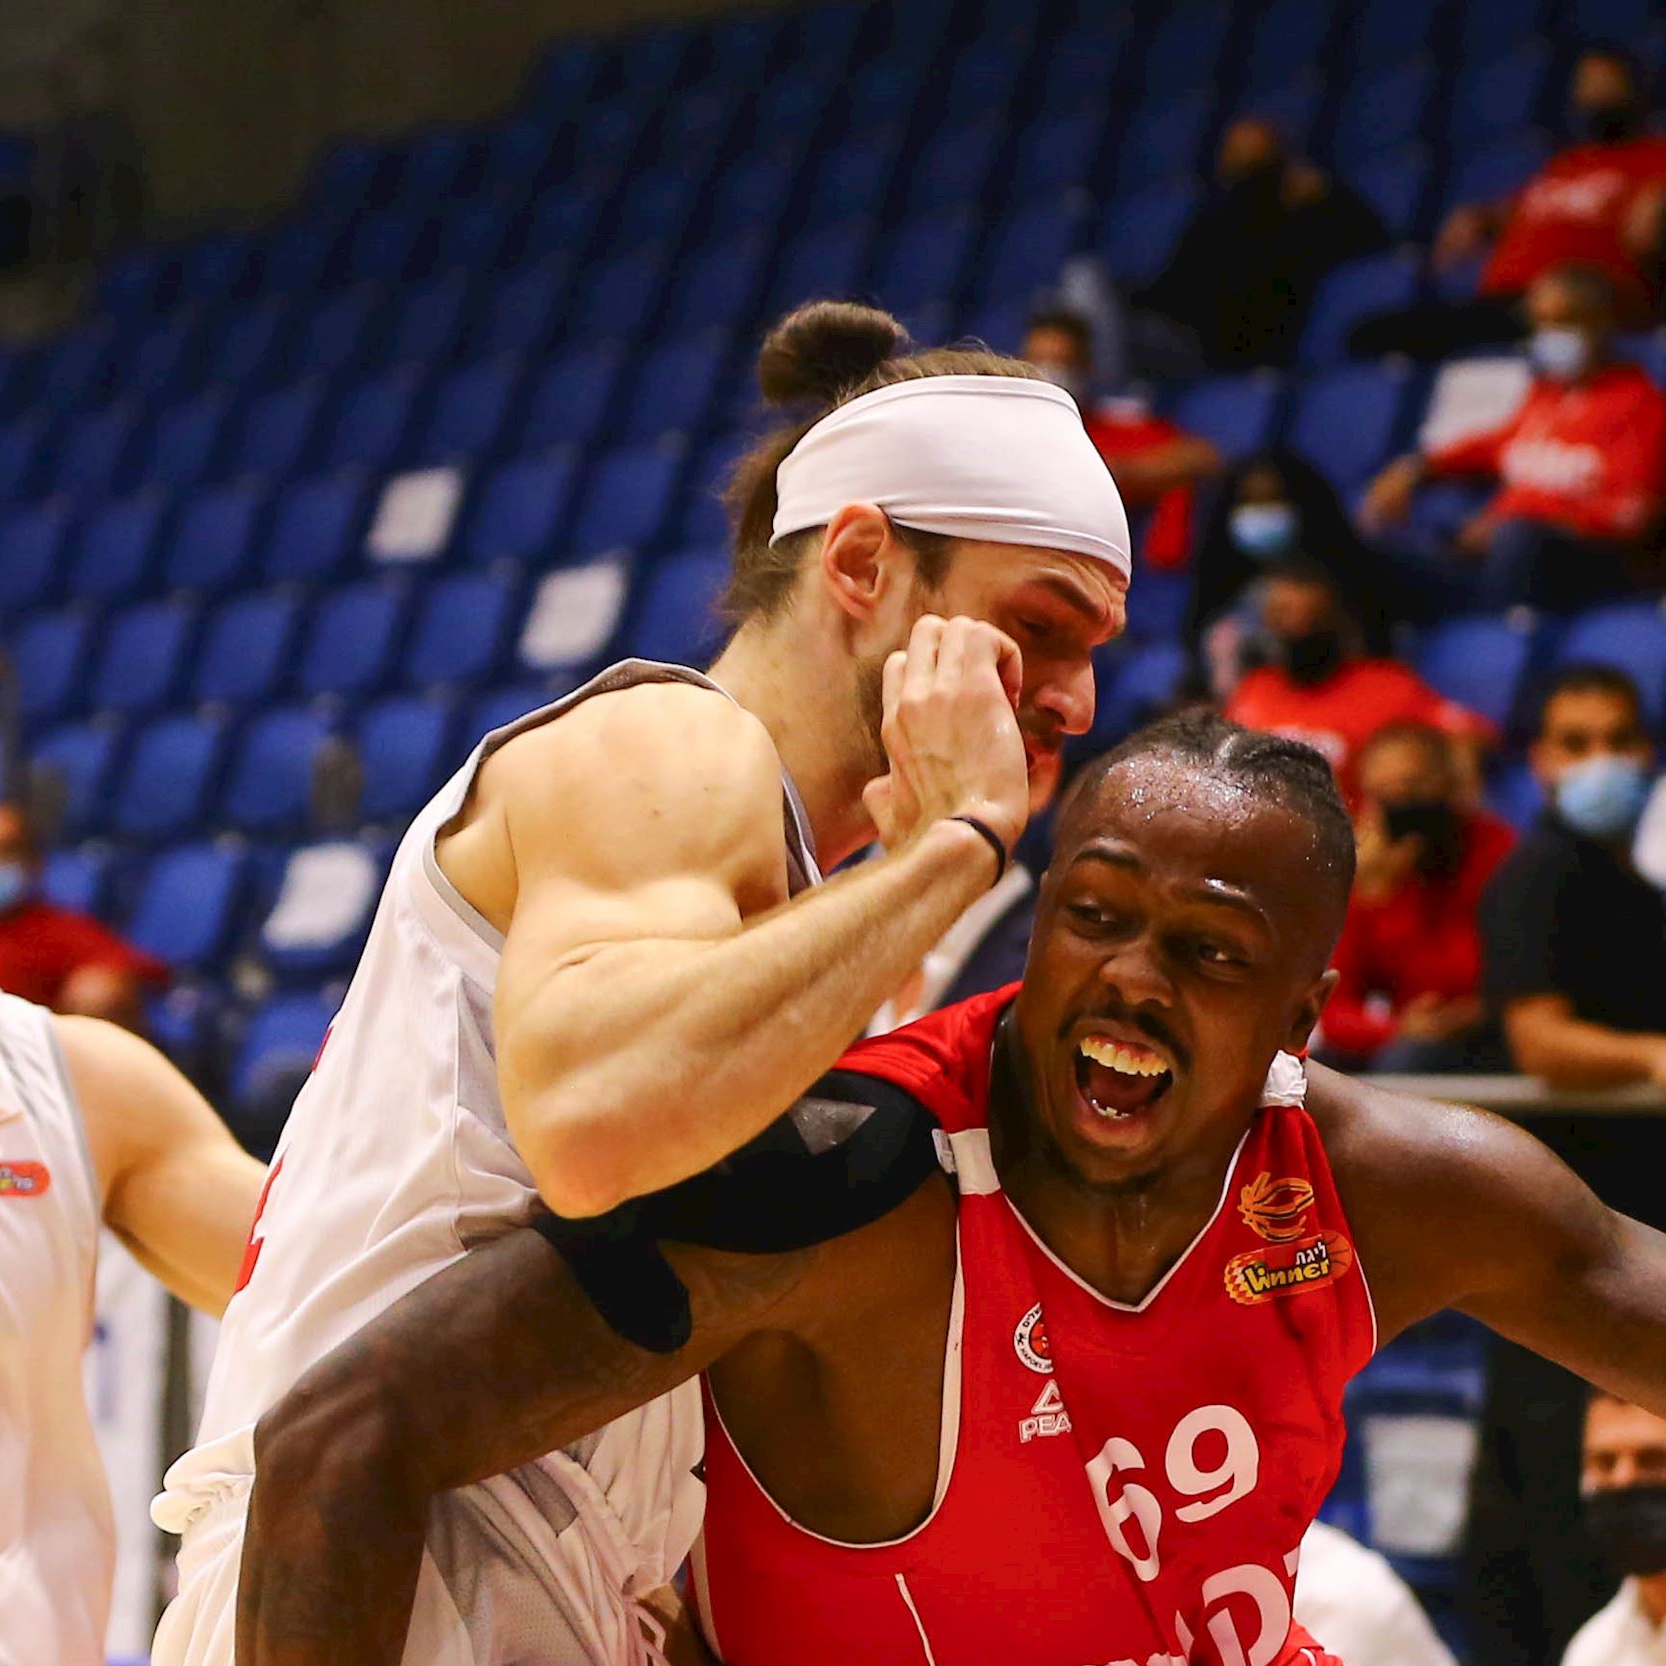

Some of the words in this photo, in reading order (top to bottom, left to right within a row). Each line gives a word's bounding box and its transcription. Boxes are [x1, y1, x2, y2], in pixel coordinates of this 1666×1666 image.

[1295, 1241, 1328, 1266] ליגת
[1018, 1411, 1072, 1443] PEA
[1086, 1404, 1260, 1581] 69
